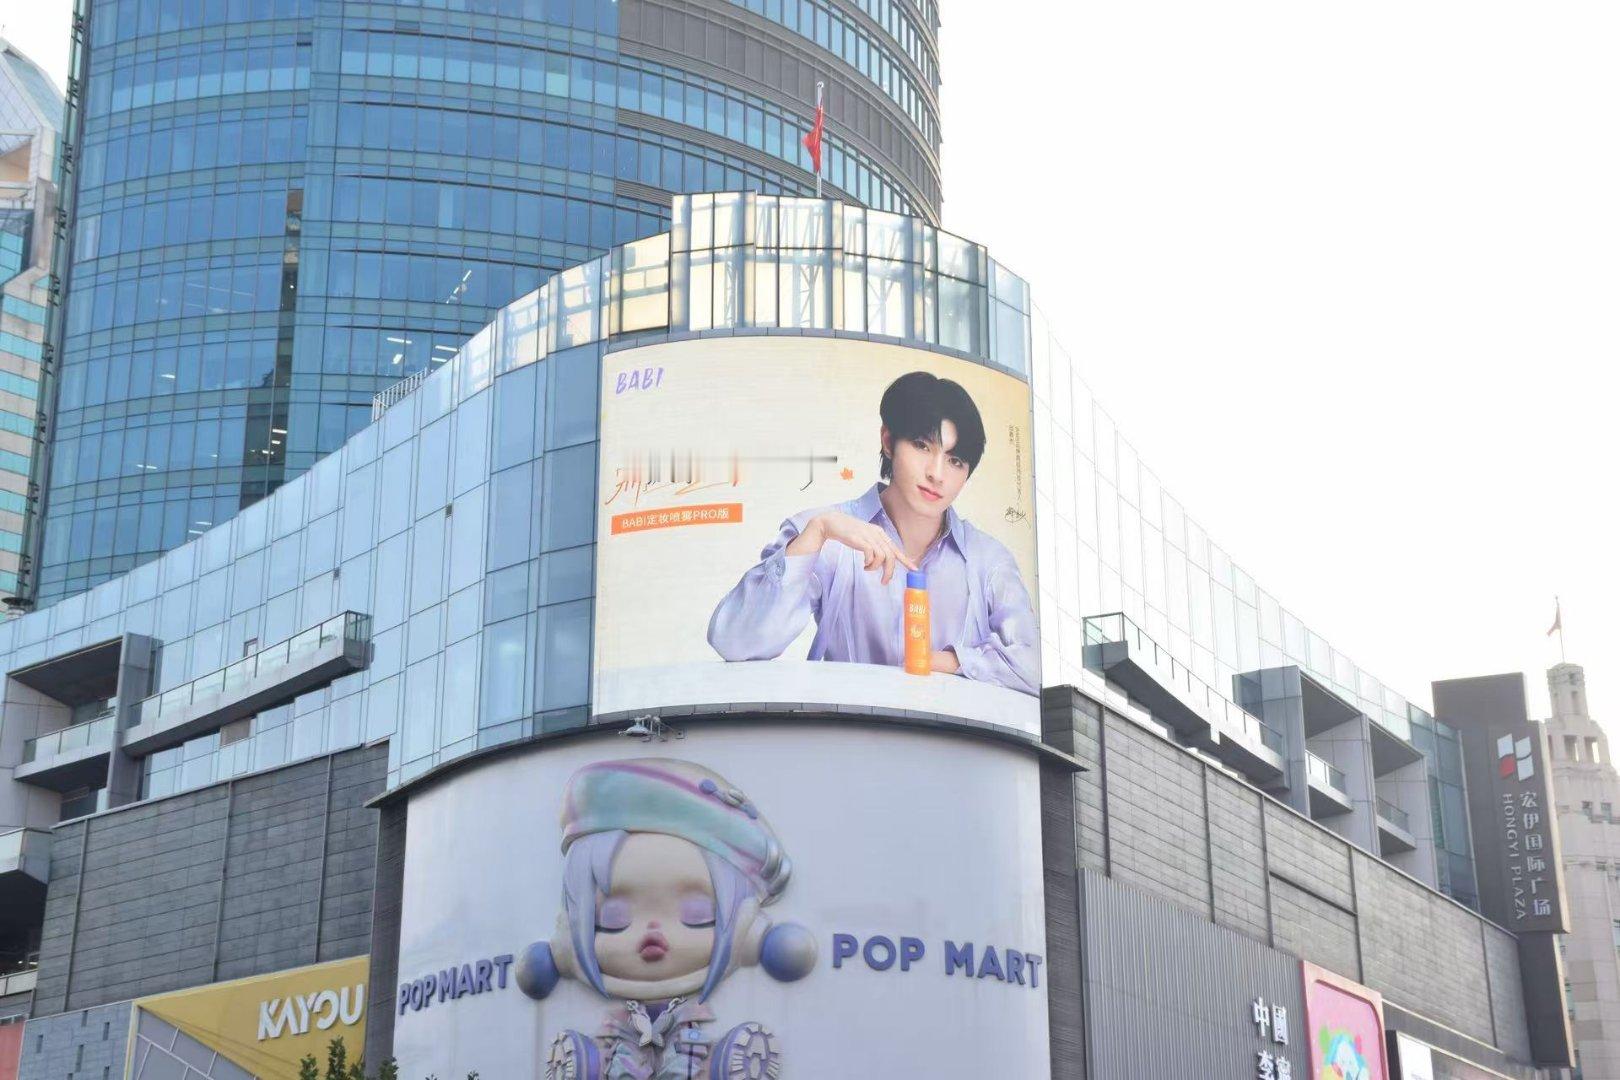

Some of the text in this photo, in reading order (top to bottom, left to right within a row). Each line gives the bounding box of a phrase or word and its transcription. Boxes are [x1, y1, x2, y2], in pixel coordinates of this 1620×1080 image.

[616, 367, 664, 394] BABI
[1502, 793, 1527, 920] HONGYI PLAZA
[1519, 791, 1551, 916] 宏伊国际广场
[398, 954, 514, 1016] POP MART
[831, 933, 1043, 988] POP MART
[257, 983, 364, 1041] KAYOU
